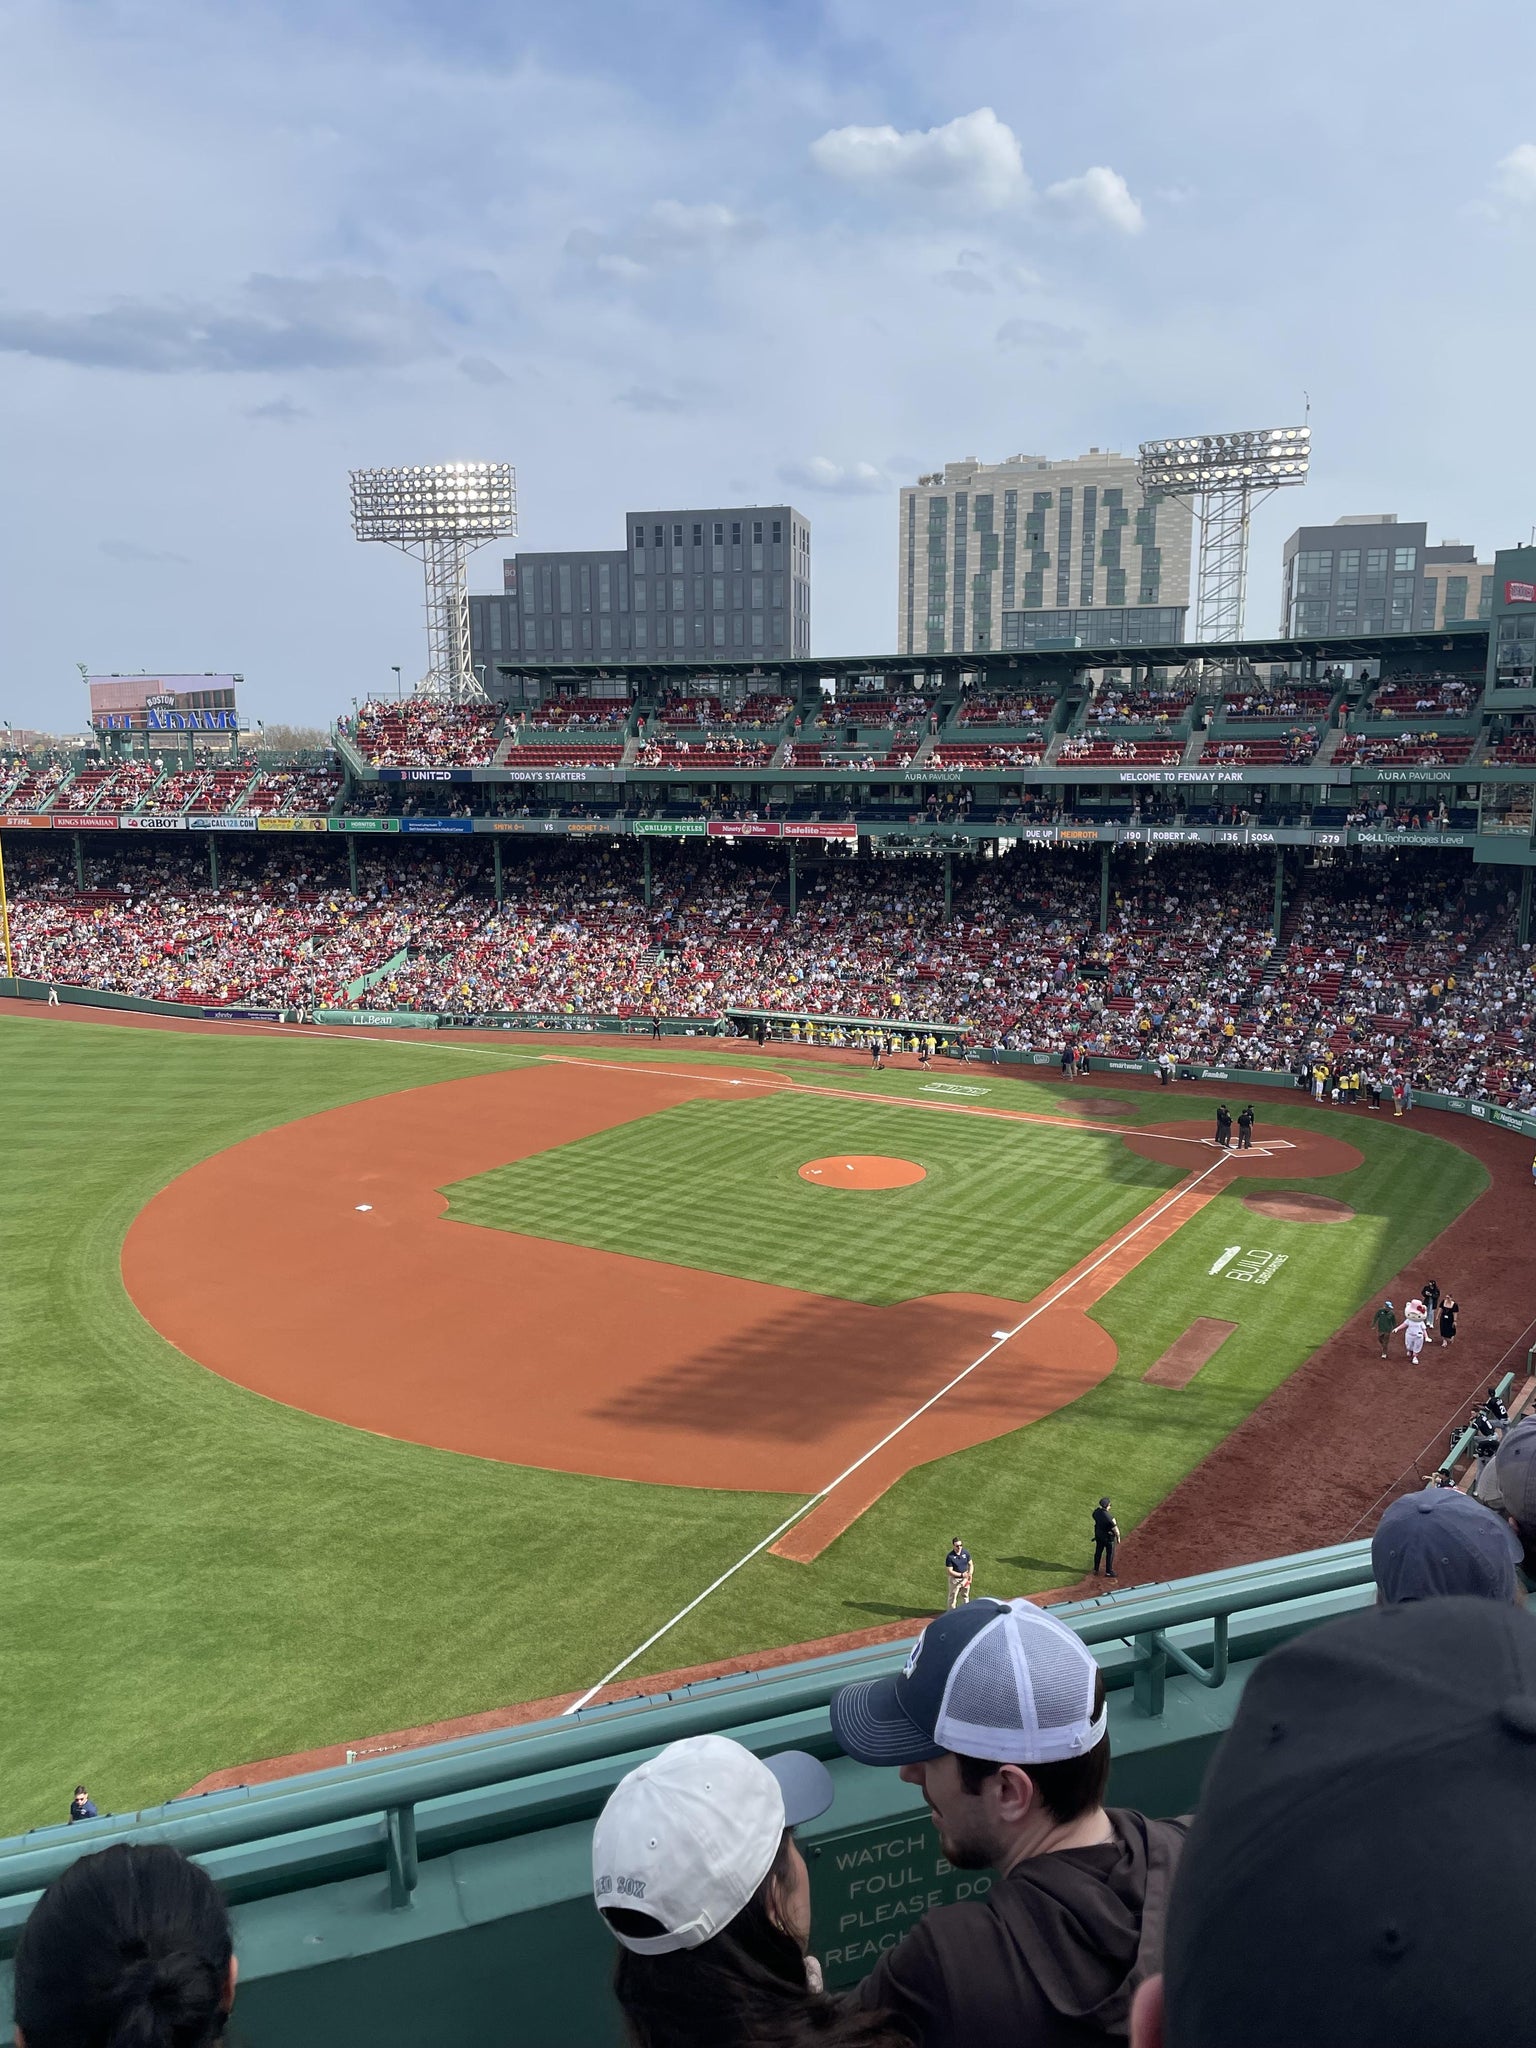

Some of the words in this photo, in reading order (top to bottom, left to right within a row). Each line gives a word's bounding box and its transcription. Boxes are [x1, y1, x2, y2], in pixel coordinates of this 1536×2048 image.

[146, 695, 175, 708] BOSTON
[510, 772, 543, 780] TODAY'S
[545, 772, 586, 780] STARTERS
[929, 773, 961, 781] PAVILION
[1120, 773, 1160, 781] WELCOME
[1164, 773, 1175, 781] TO
[1177, 773, 1215, 781] FENWAY
[1218, 772, 1243, 781] PARK
[1409, 772, 1451, 781] PAVILION
[80, 819, 114, 827] HAWAIIAN
[493, 823, 513, 831] SMITH
[544, 823, 554, 831] VS
[567, 824, 597, 832] CROCHET
[644, 824, 672, 832] GRILLO'S
[674, 824, 703, 832] PICKLES
[722, 825, 741, 833] Ninety
[785, 826, 819, 835] Safelite
[1026, 830, 1041, 838] DUE
[1043, 830, 1053, 838] UP
[1060, 831, 1098, 839] MEIDROTH
[1123, 831, 1141, 840] .190
[1153, 832, 1185, 840] ROBERT
[1187, 832, 1201, 840] JR.
[1251, 833, 1274, 842] SOSA
[1318, 834, 1340, 844] .279
[1358, 833, 1383, 843] DELL
[1383, 834, 1439, 845] Technologies
[1440, 834, 1464, 845] Level
[1109, 1062, 1143, 1071] smartwater
[1225, 1249, 1274, 1282] BUILD
[835, 1832, 926, 1872] WATCH
[616, 1876, 647, 1899] SOX
[849, 1866, 924, 1901] FOUL
[839, 1889, 944, 1934] PLEASE
[956, 1876, 992, 1901] DO
